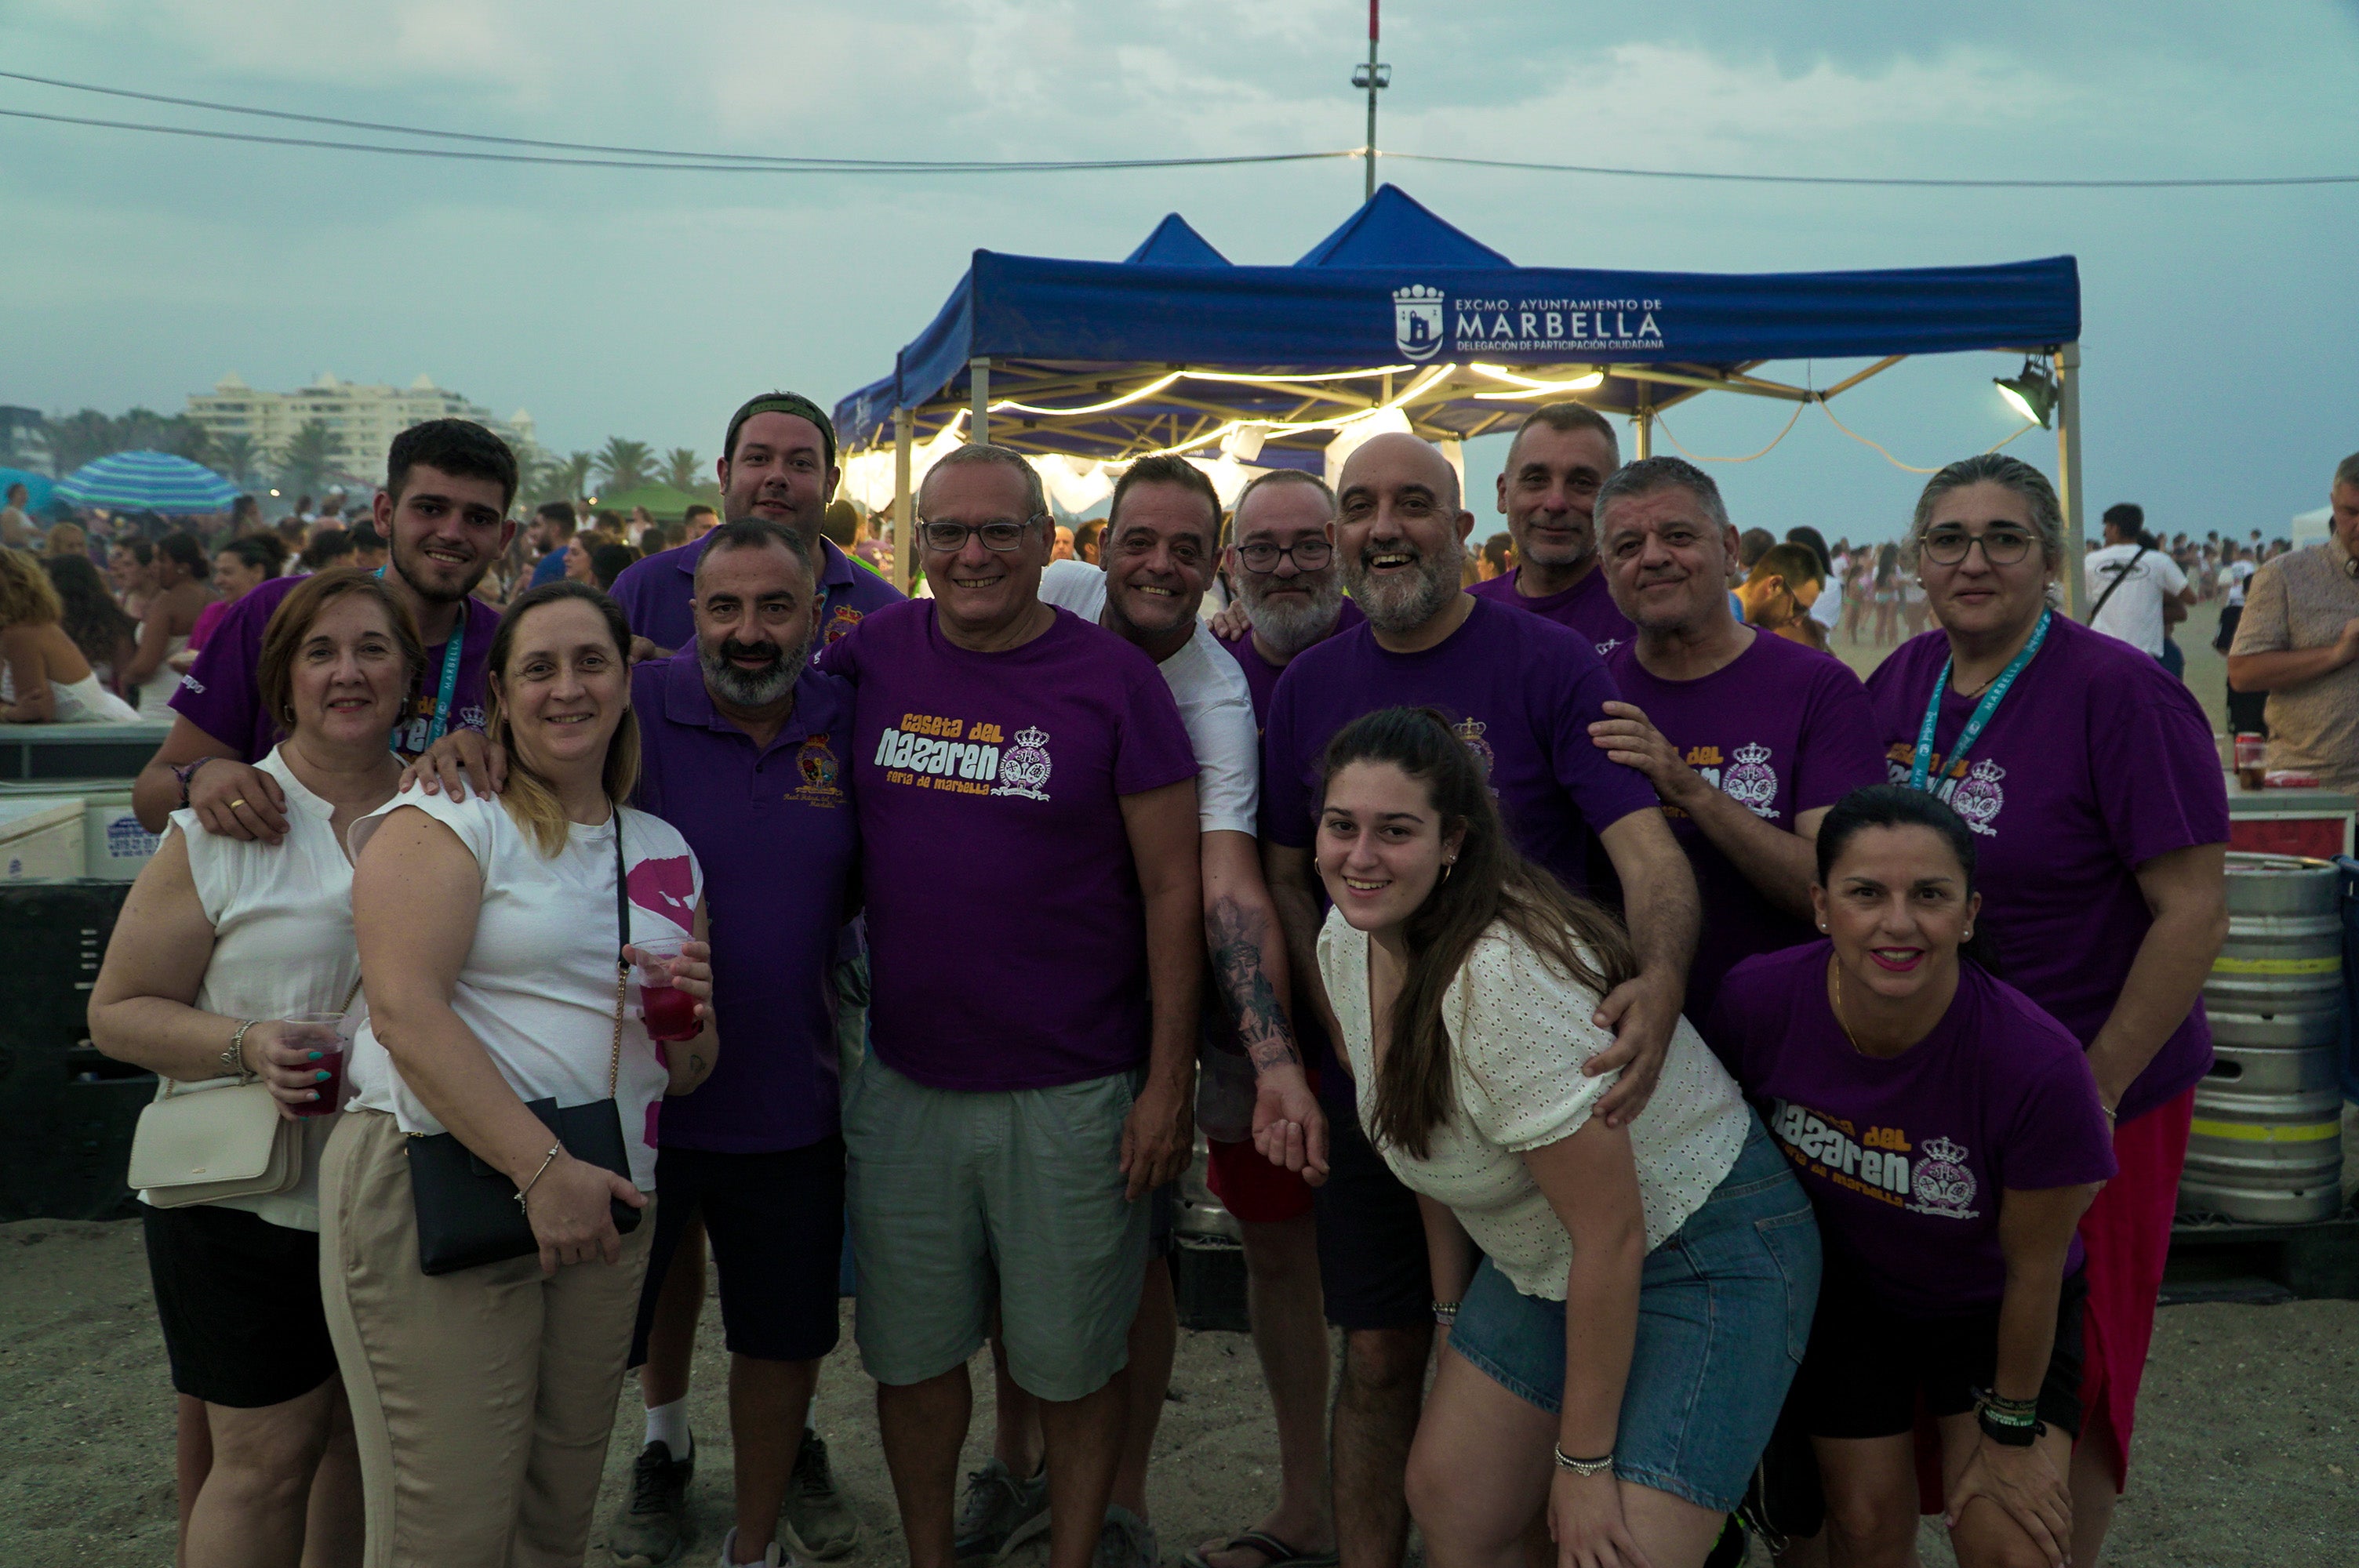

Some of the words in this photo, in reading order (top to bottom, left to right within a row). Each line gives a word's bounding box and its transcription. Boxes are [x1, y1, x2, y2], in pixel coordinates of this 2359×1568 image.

[1456, 299, 1514, 311] EXCMO.
[1519, 299, 1638, 311] AYUNTAMIENTO
[1643, 299, 1663, 310] DE
[1456, 312, 1662, 339] MARBELLA
[1457, 339, 1518, 351] DELEGACIÓN
[1520, 340, 1532, 350] DE
[1534, 338, 1606, 350] PARTICIPACIÓN
[1608, 339, 1664, 350] CIUDADANA
[444, 639, 460, 690] MARBELLA
[1983, 662, 2023, 710] MARBELLA
[916, 775, 931, 789] de
